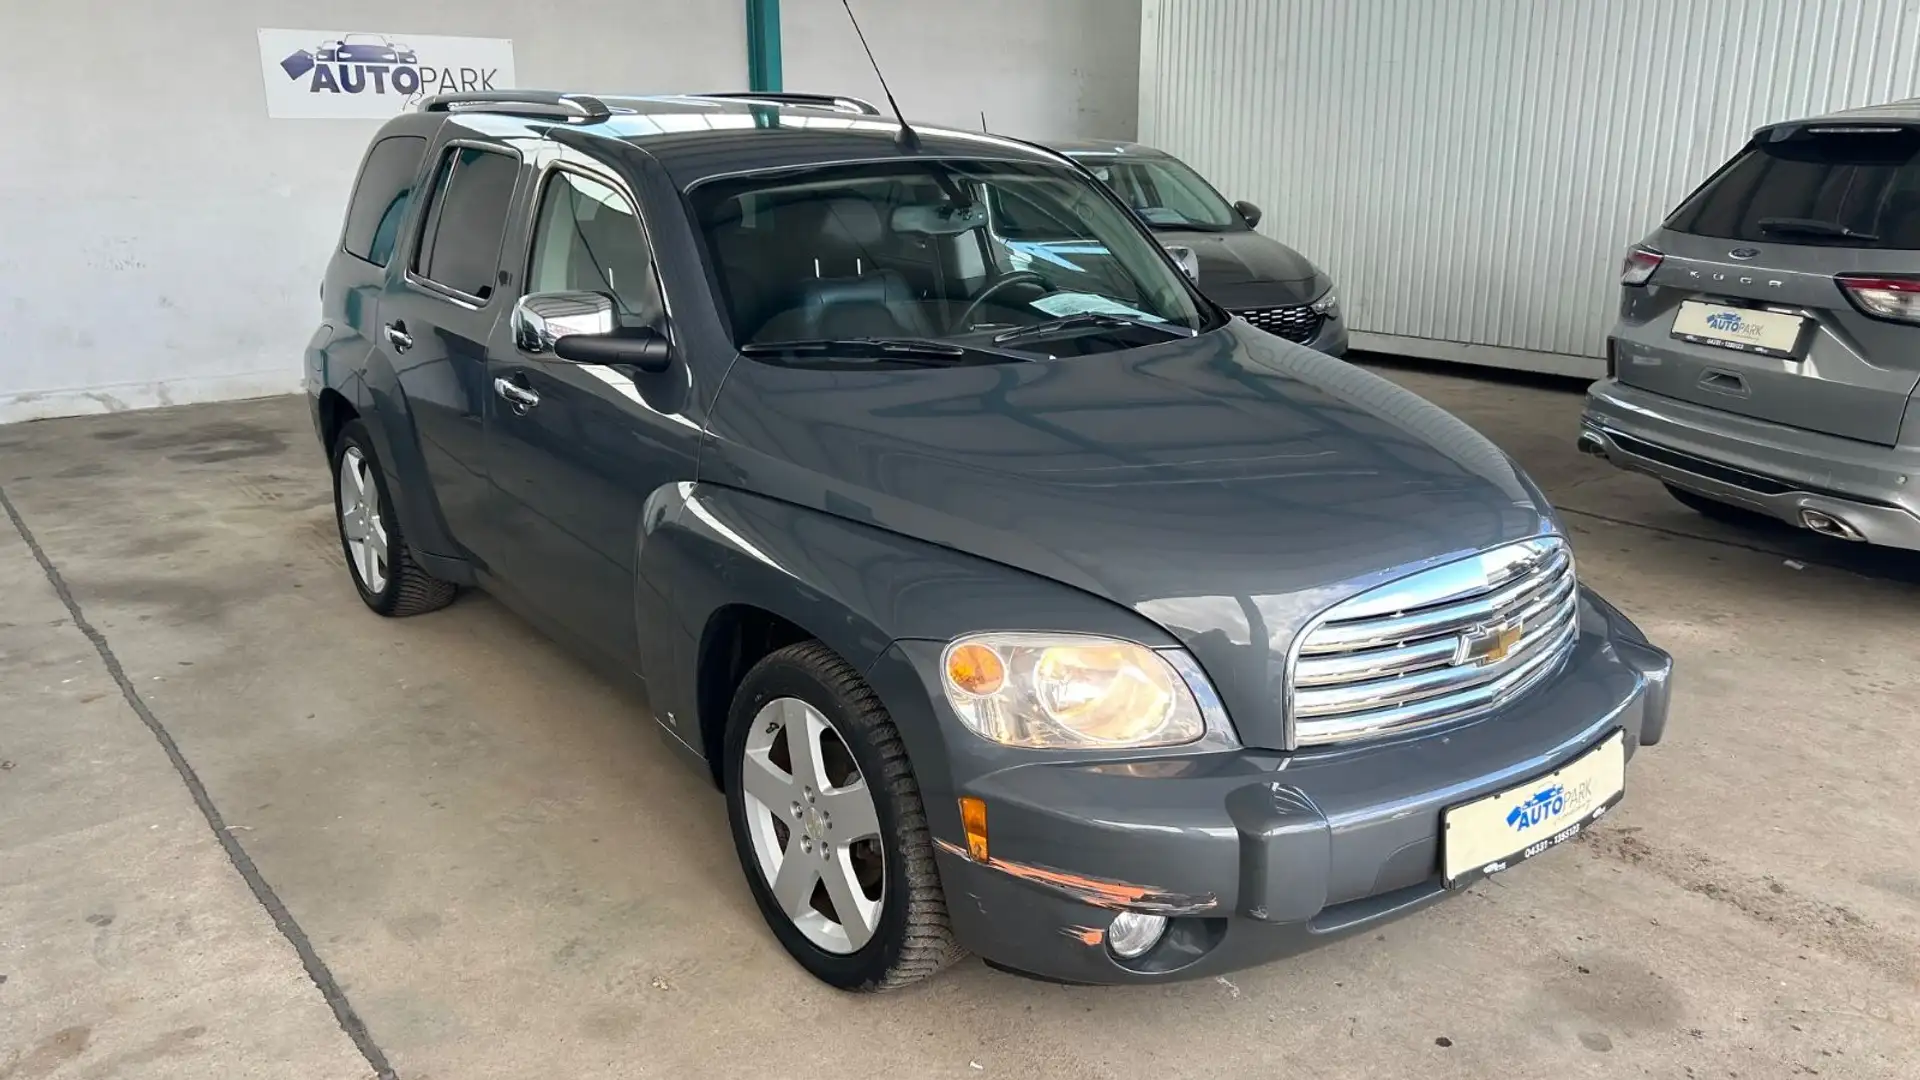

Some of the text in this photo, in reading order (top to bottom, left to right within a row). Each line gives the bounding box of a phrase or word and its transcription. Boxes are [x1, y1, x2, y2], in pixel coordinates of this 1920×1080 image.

[310, 63, 498, 95] AUTOPARK
[1690, 270, 1783, 288] KUGA
[1524, 839, 1548, 858] 04331
